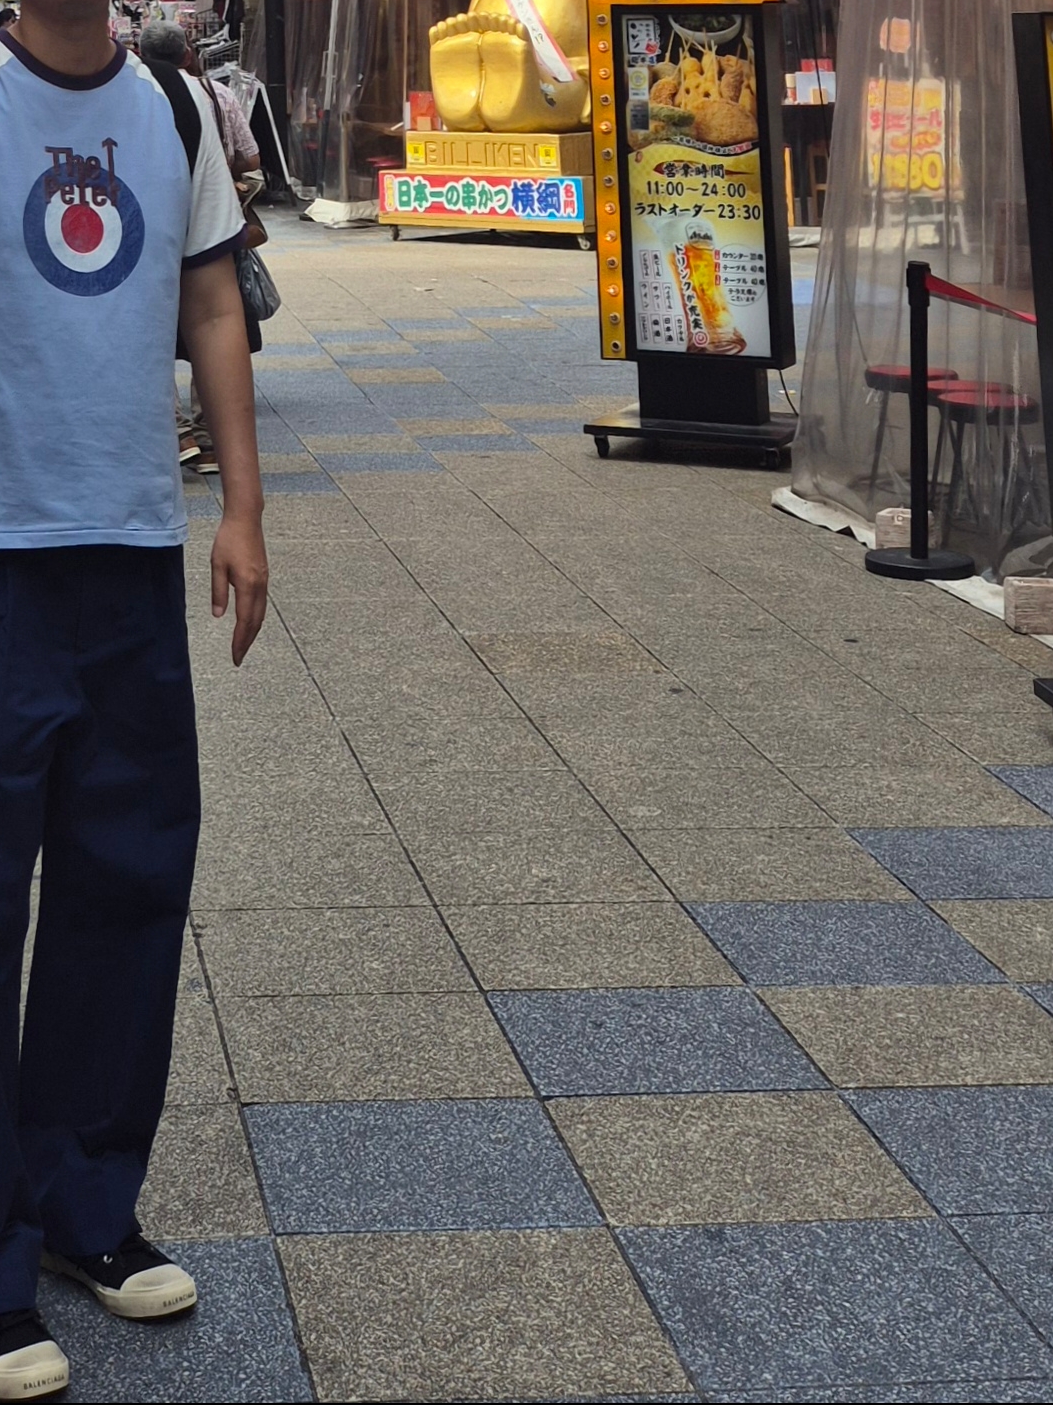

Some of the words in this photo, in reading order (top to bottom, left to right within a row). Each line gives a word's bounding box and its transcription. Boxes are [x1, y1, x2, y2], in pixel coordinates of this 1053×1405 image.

[44, 146, 102, 179] The
[424, 140, 539, 167] BILLIKEN
[663, 163, 726, 179] 営業時間
[397, 179, 509, 211] 日本一の串かつ
[511, 181, 562, 215] 横綱
[563, 183, 577, 214] 名門
[635, 201, 715, 218] ラストオーダー
[718, 203, 761, 220] 23:30
